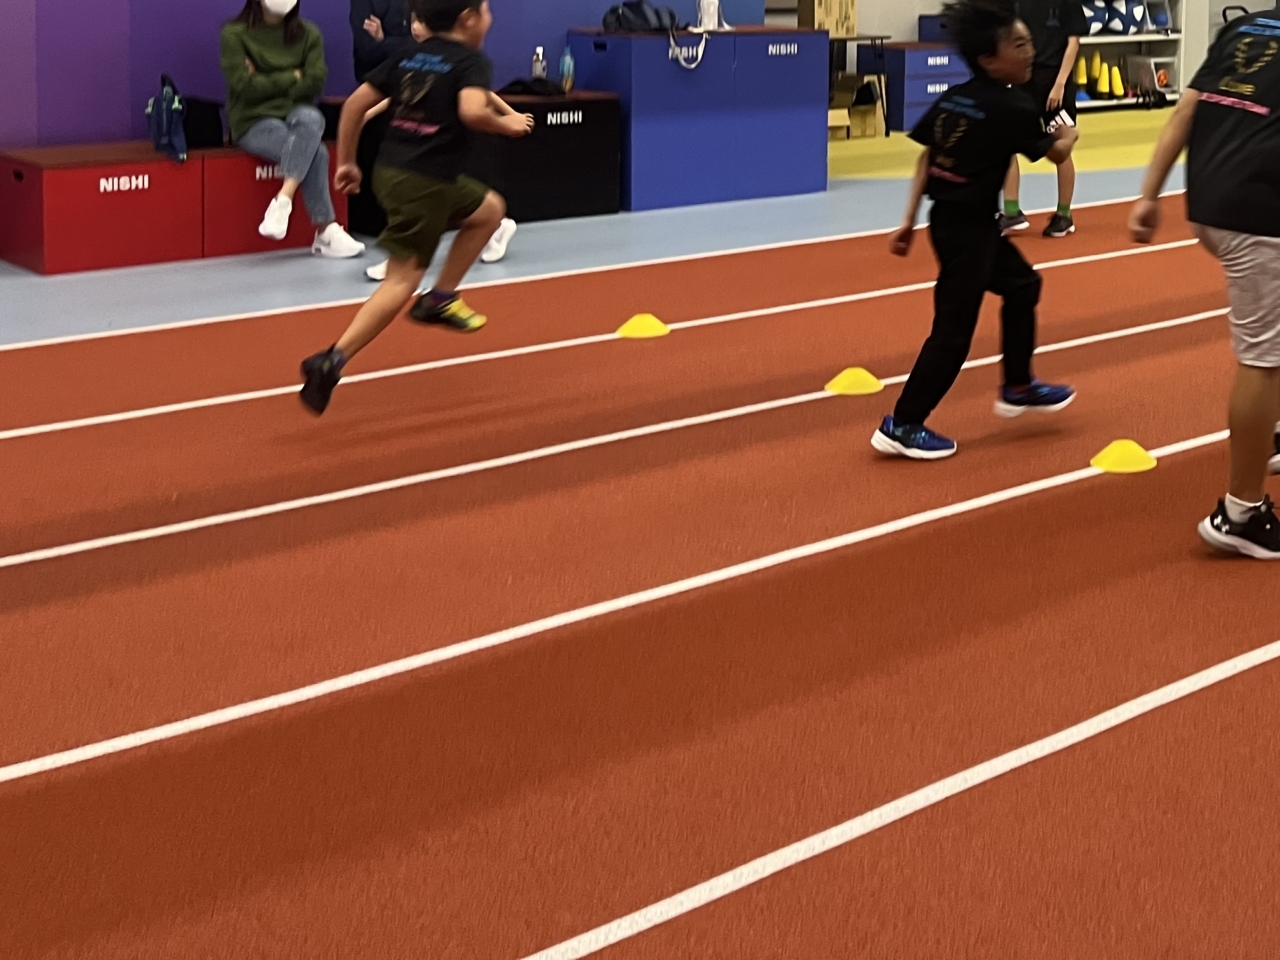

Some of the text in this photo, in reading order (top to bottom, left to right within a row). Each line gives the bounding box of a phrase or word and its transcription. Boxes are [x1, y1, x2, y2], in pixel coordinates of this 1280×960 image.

[768, 43, 798, 56] NISHI
[547, 111, 583, 125] NISHI
[99, 174, 149, 193] NISHI
